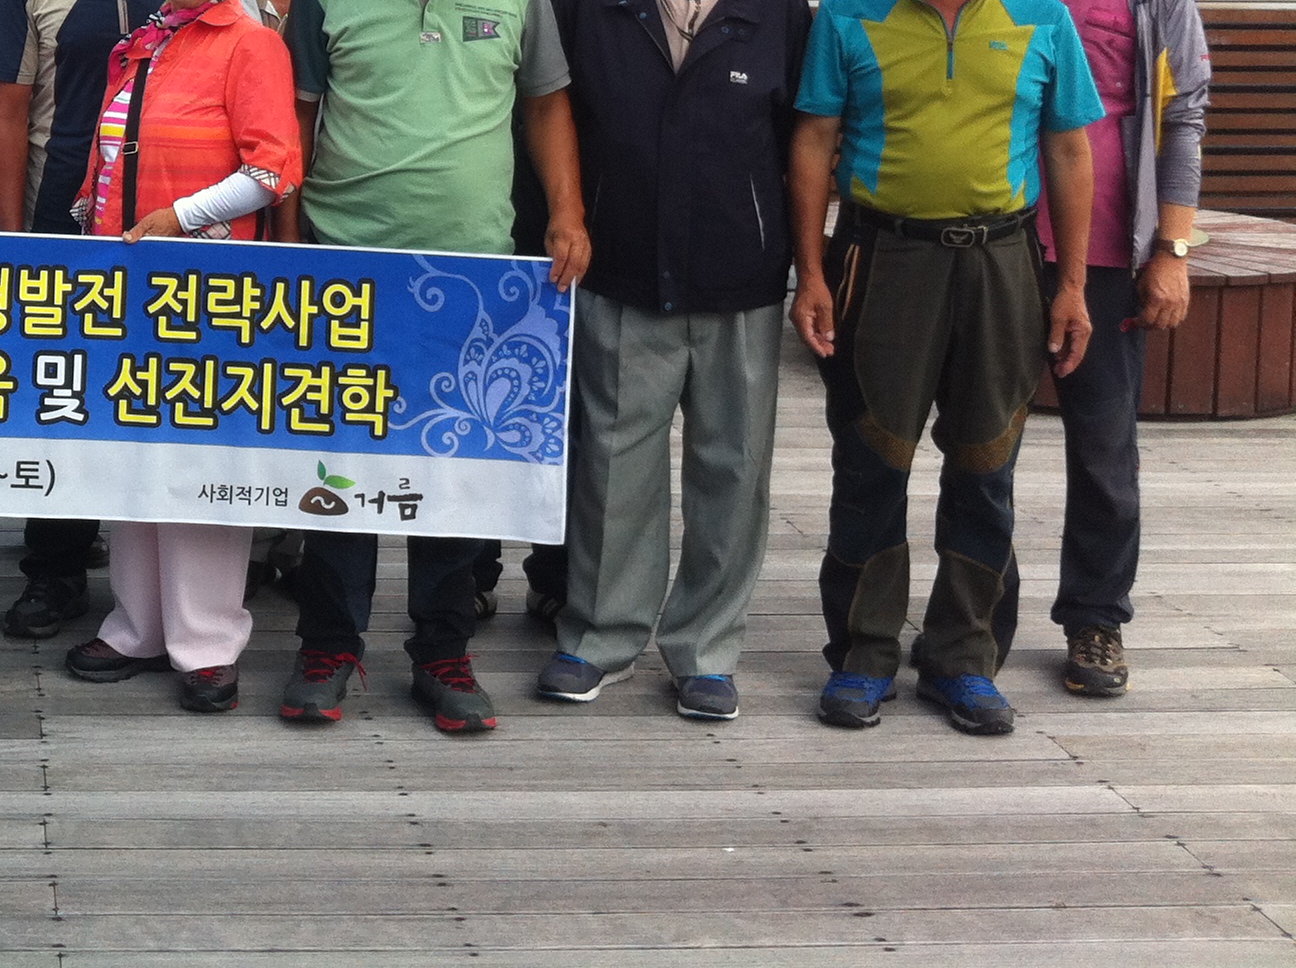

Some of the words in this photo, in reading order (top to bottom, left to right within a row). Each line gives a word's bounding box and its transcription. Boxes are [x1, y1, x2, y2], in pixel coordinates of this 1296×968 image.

[146, 273, 372, 350] 전략사업
[36, 353, 86, 422] 및
[106, 357, 395, 436] 선진지견학
[197, 483, 289, 507] 사회적기업
[354, 477, 424, 521] 거름
